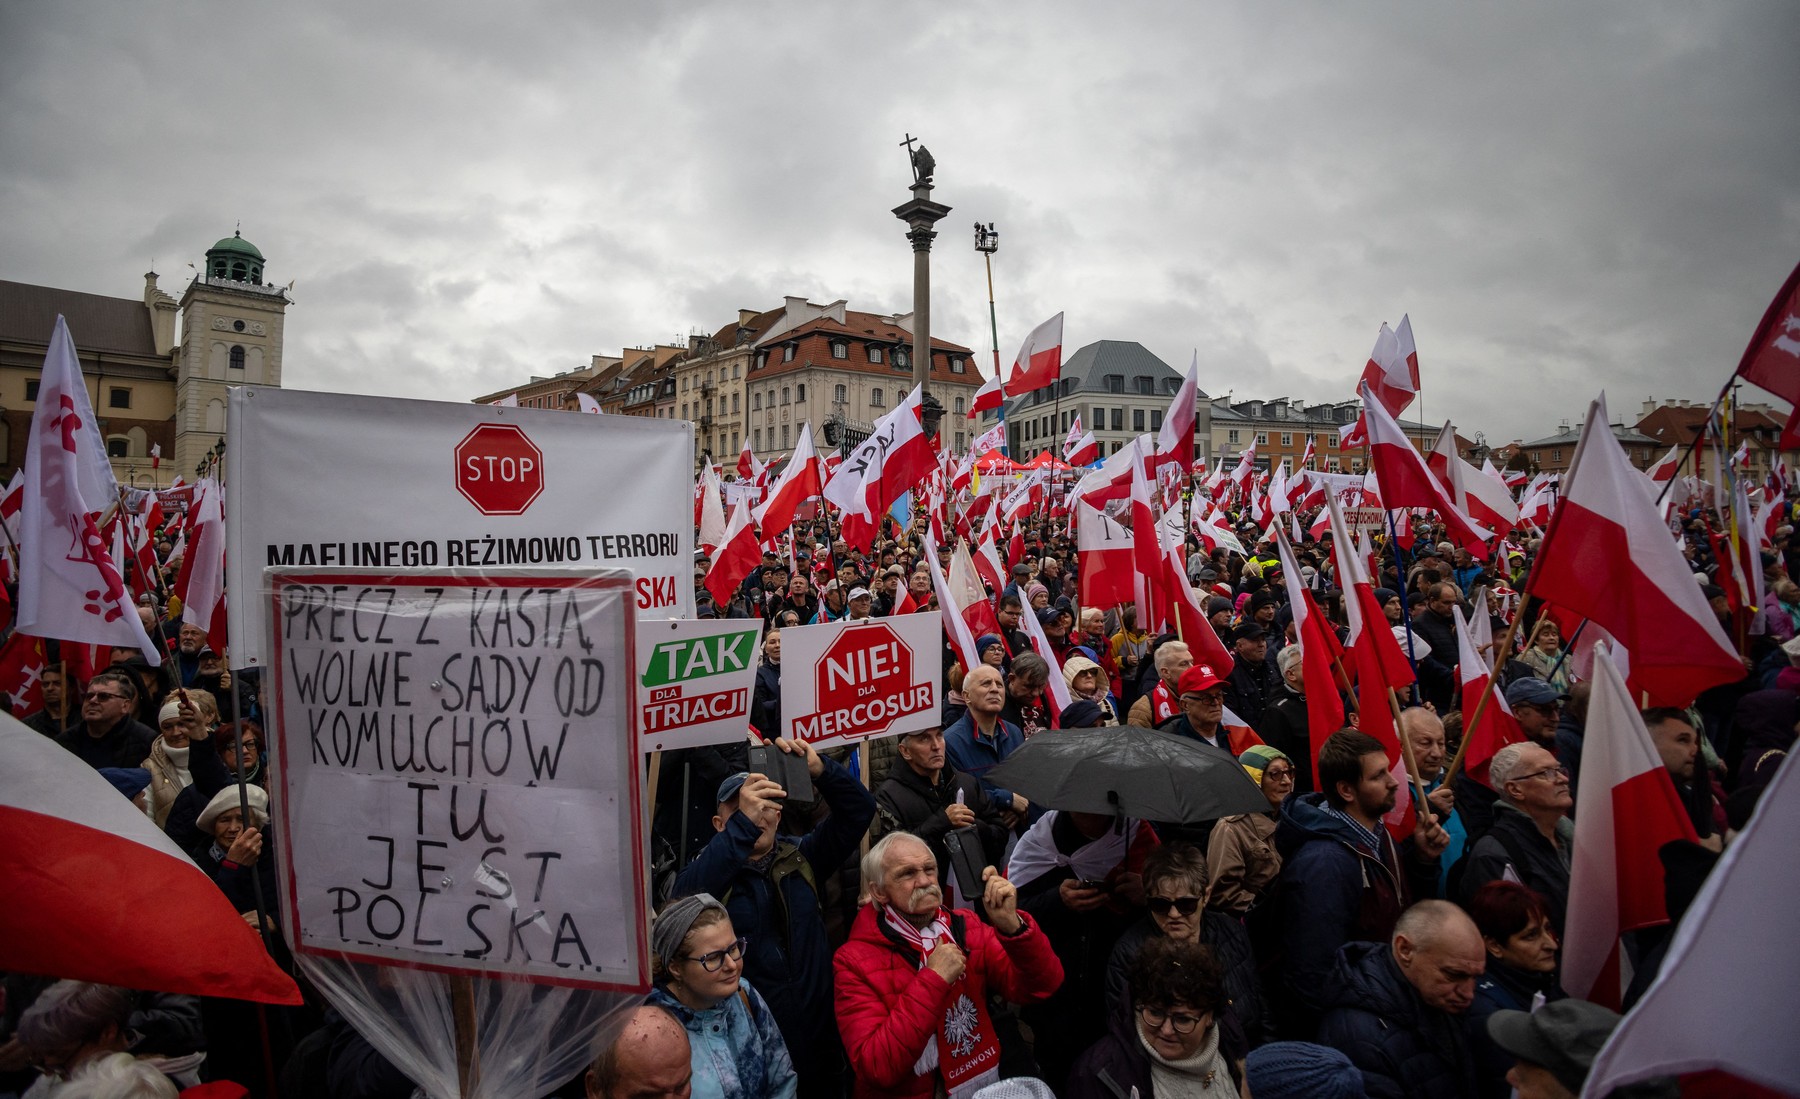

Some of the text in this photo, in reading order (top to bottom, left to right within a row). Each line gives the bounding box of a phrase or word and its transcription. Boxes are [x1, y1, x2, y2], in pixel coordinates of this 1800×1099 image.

[466, 455, 534, 484] STOP
[446, 534, 581, 566] REŻIMOWO
[587, 533, 678, 560] TERRORU
[636, 576, 676, 609] SKA
[283, 585, 593, 654] PRECZ Z KASTĄ
[659, 634, 746, 680] TAK
[826, 641, 901, 692] NIE!
[290, 647, 605, 718] WOLNE SĄDY OD
[656, 688, 678, 701] DLA
[857, 684, 877, 697] DLA
[642, 690, 746, 730] TRIACJI
[795, 686, 932, 740] MERCOSUR
[308, 708, 570, 781] KOMUCHÓW
[407, 782, 505, 844] TU
[362, 835, 562, 902] JEST
[948, 1046, 997, 1079] CZERWONI
